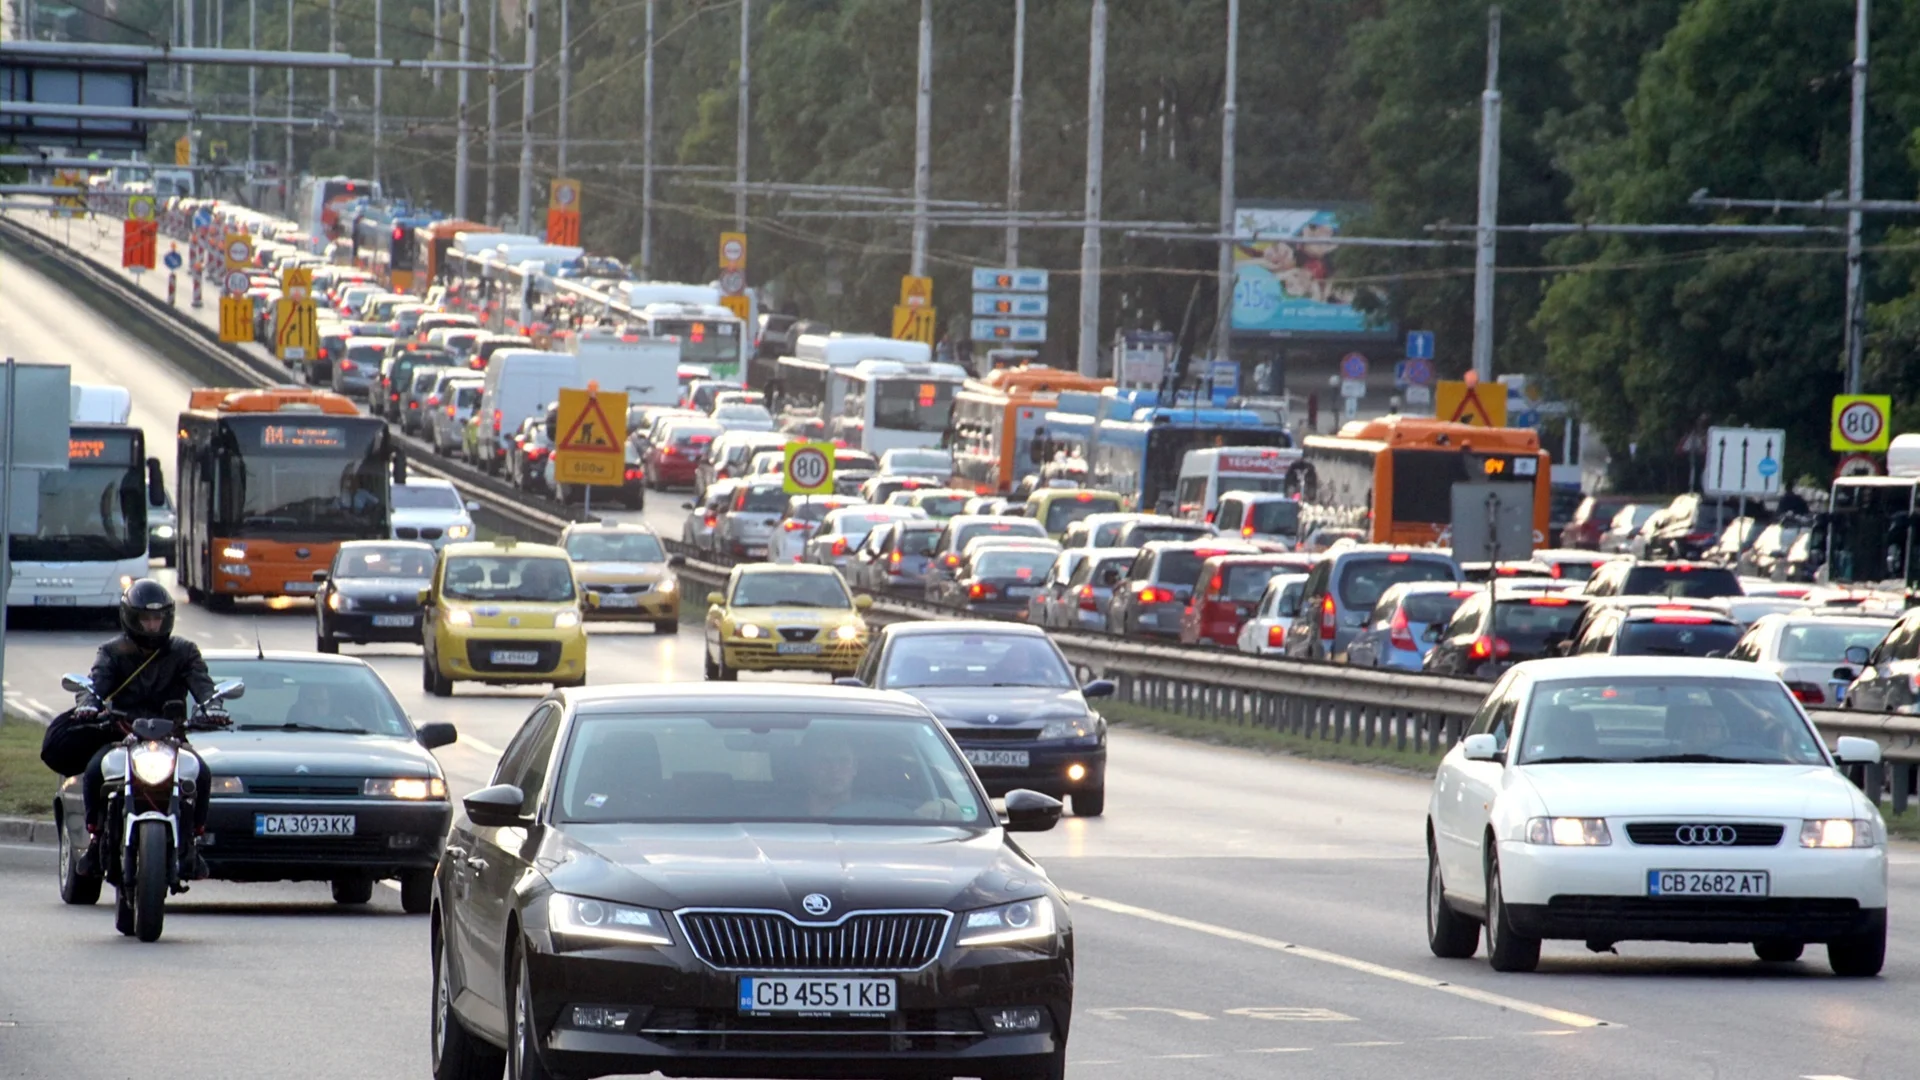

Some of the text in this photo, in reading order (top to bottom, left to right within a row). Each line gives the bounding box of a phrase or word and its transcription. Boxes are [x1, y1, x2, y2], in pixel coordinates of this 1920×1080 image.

[1847, 412, 1874, 433] 80
[797, 457, 821, 478] 80
[1661, 874, 1686, 892] CB
[1689, 874, 1735, 893] 2682
[1740, 875, 1763, 893] AT
[757, 982, 788, 1006] CB
[794, 982, 850, 1007] 4551
[859, 982, 890, 1007] KB
